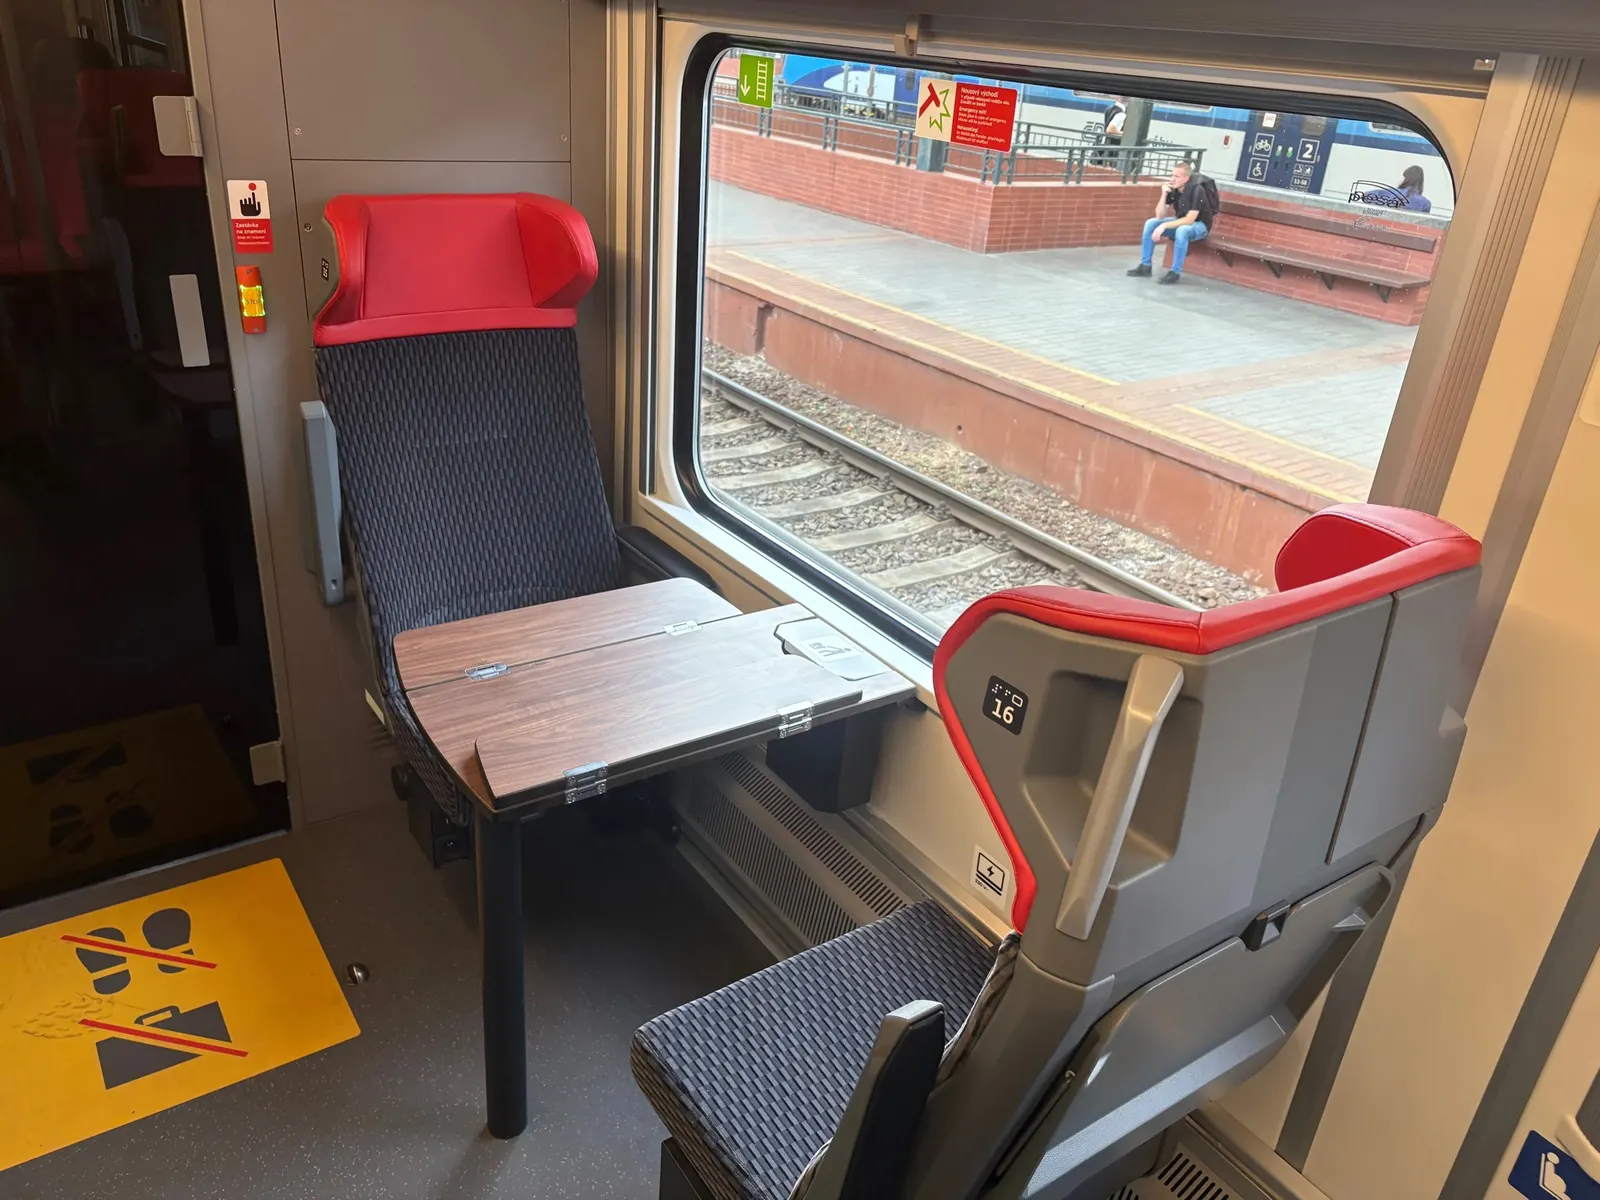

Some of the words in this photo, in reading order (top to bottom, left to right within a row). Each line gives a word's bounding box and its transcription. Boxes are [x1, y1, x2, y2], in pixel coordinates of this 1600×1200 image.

[1302, 143, 1314, 159] 2
[1348, 191, 1400, 209] pesa
[992, 698, 1014, 724] 16
